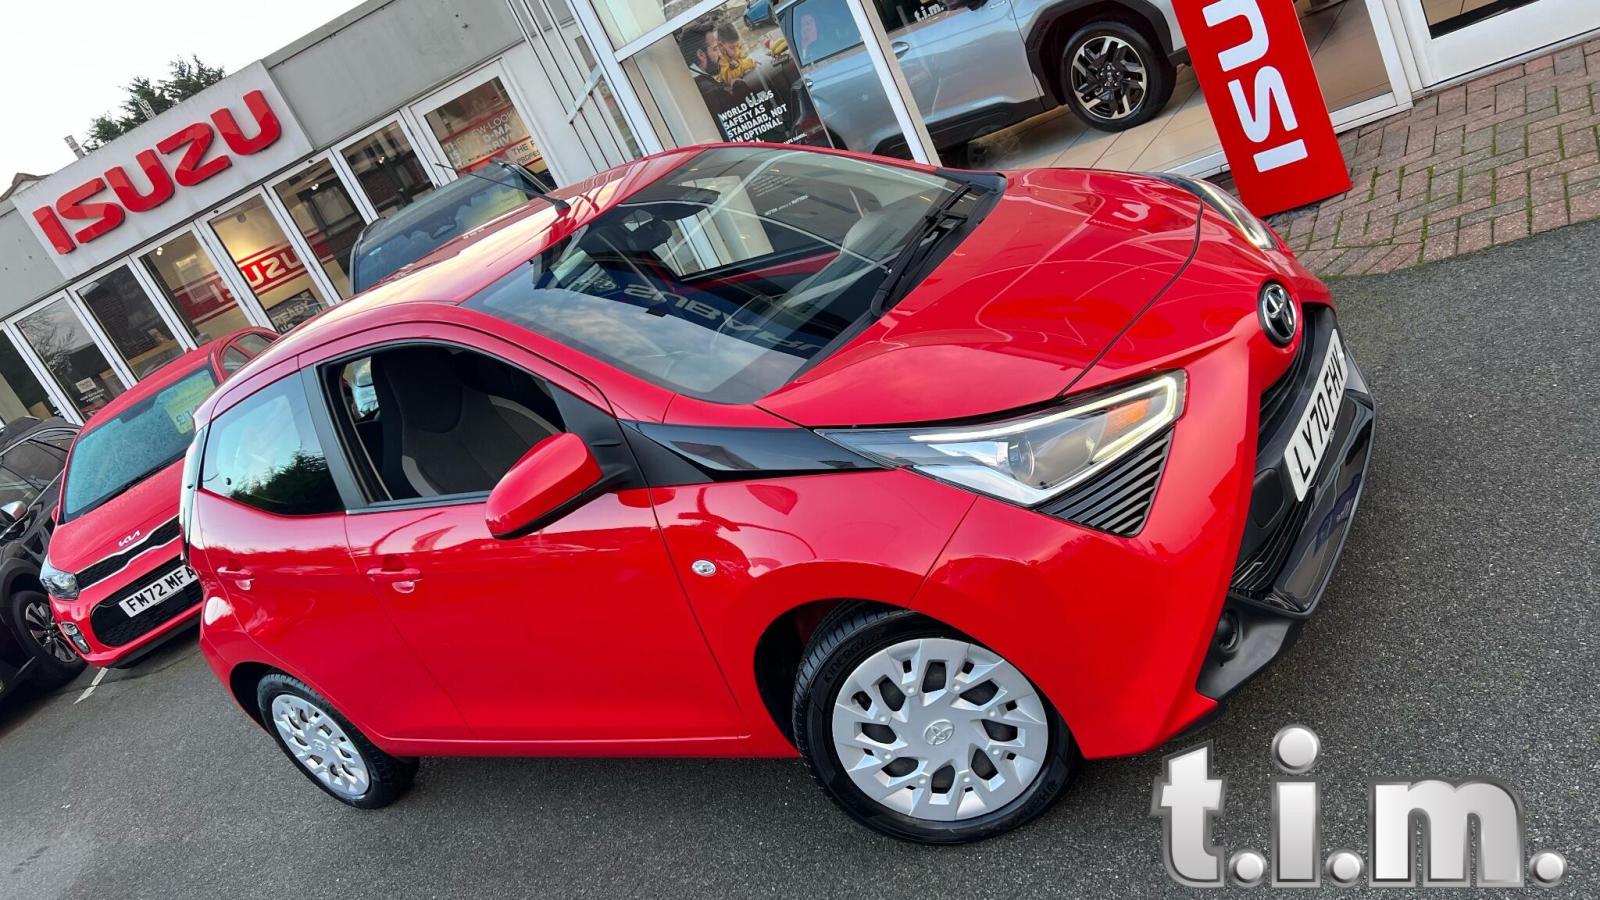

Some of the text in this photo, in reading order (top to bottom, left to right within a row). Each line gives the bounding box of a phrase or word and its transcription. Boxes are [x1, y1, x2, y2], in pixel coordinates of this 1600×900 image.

[719, 103, 748, 121] WORLD
[723, 104, 766, 130] SAFETY AS
[727, 103, 788, 138] STANDARD, NOT
[744, 117, 783, 140] OPTIONAL
[512, 143, 529, 154] THE
[32, 89, 282, 255] ISUZU
[1293, 391, 1330, 483] LY70
[126, 583, 167, 612] FM72
[164, 566, 197, 590] MFA
